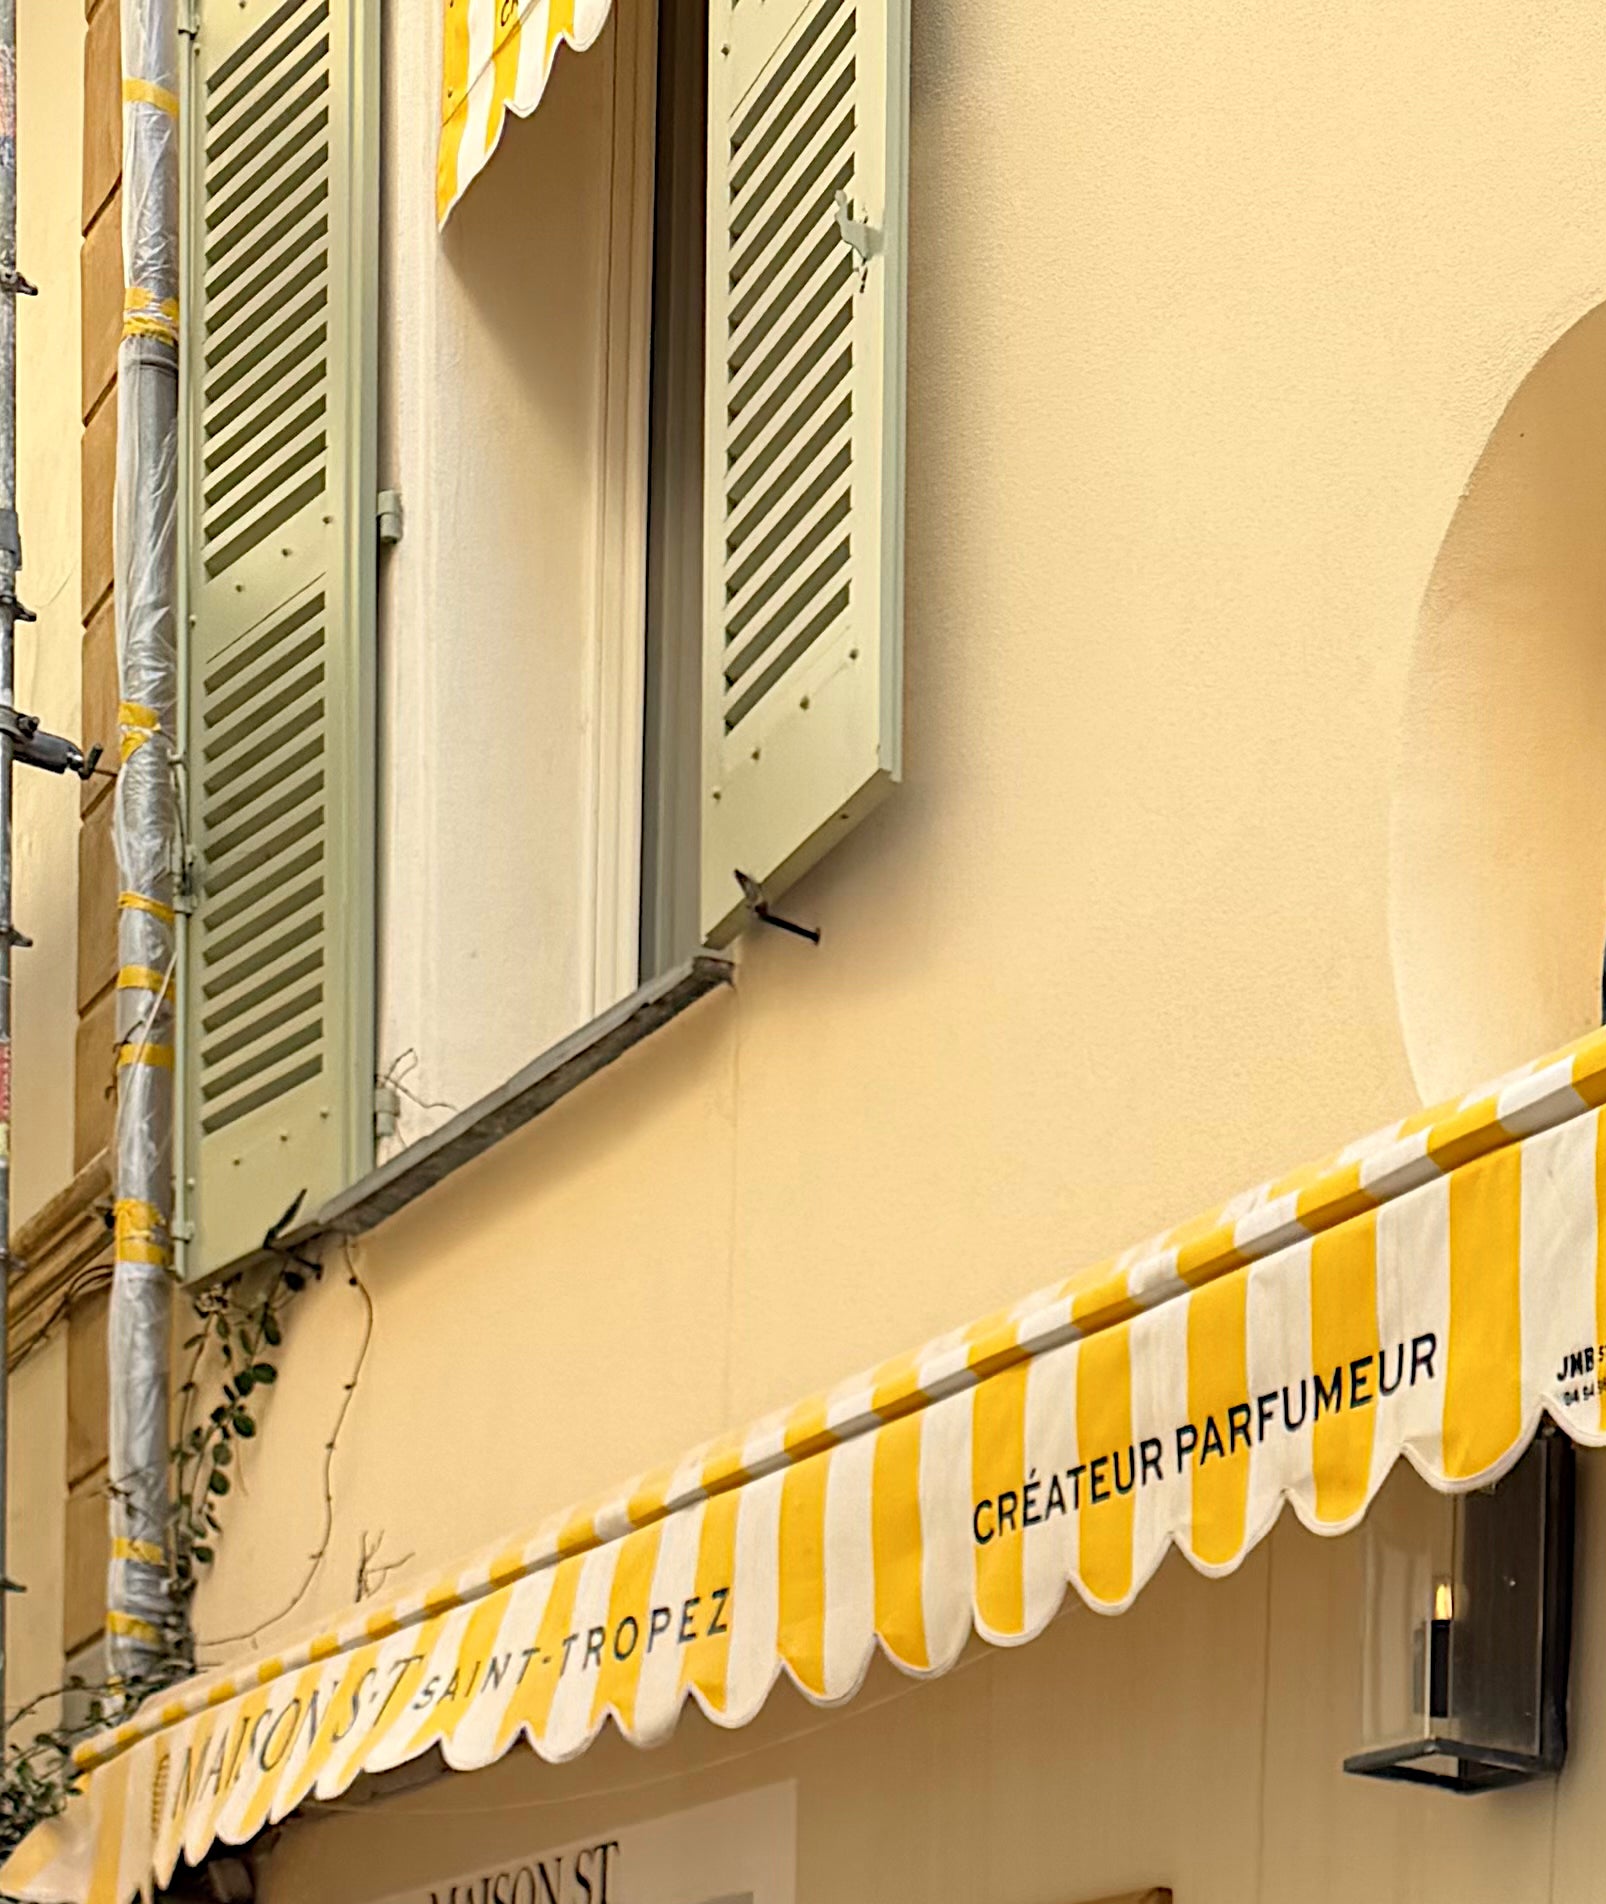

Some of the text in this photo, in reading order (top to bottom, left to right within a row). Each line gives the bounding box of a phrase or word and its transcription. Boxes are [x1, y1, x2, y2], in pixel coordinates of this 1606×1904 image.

[973, 1333, 1437, 1545] CRÉATEUR PARFUMEUR
[171, 1680, 339, 1820] MAISON
[413, 1587, 730, 1710] SAINT-TROPEZ
